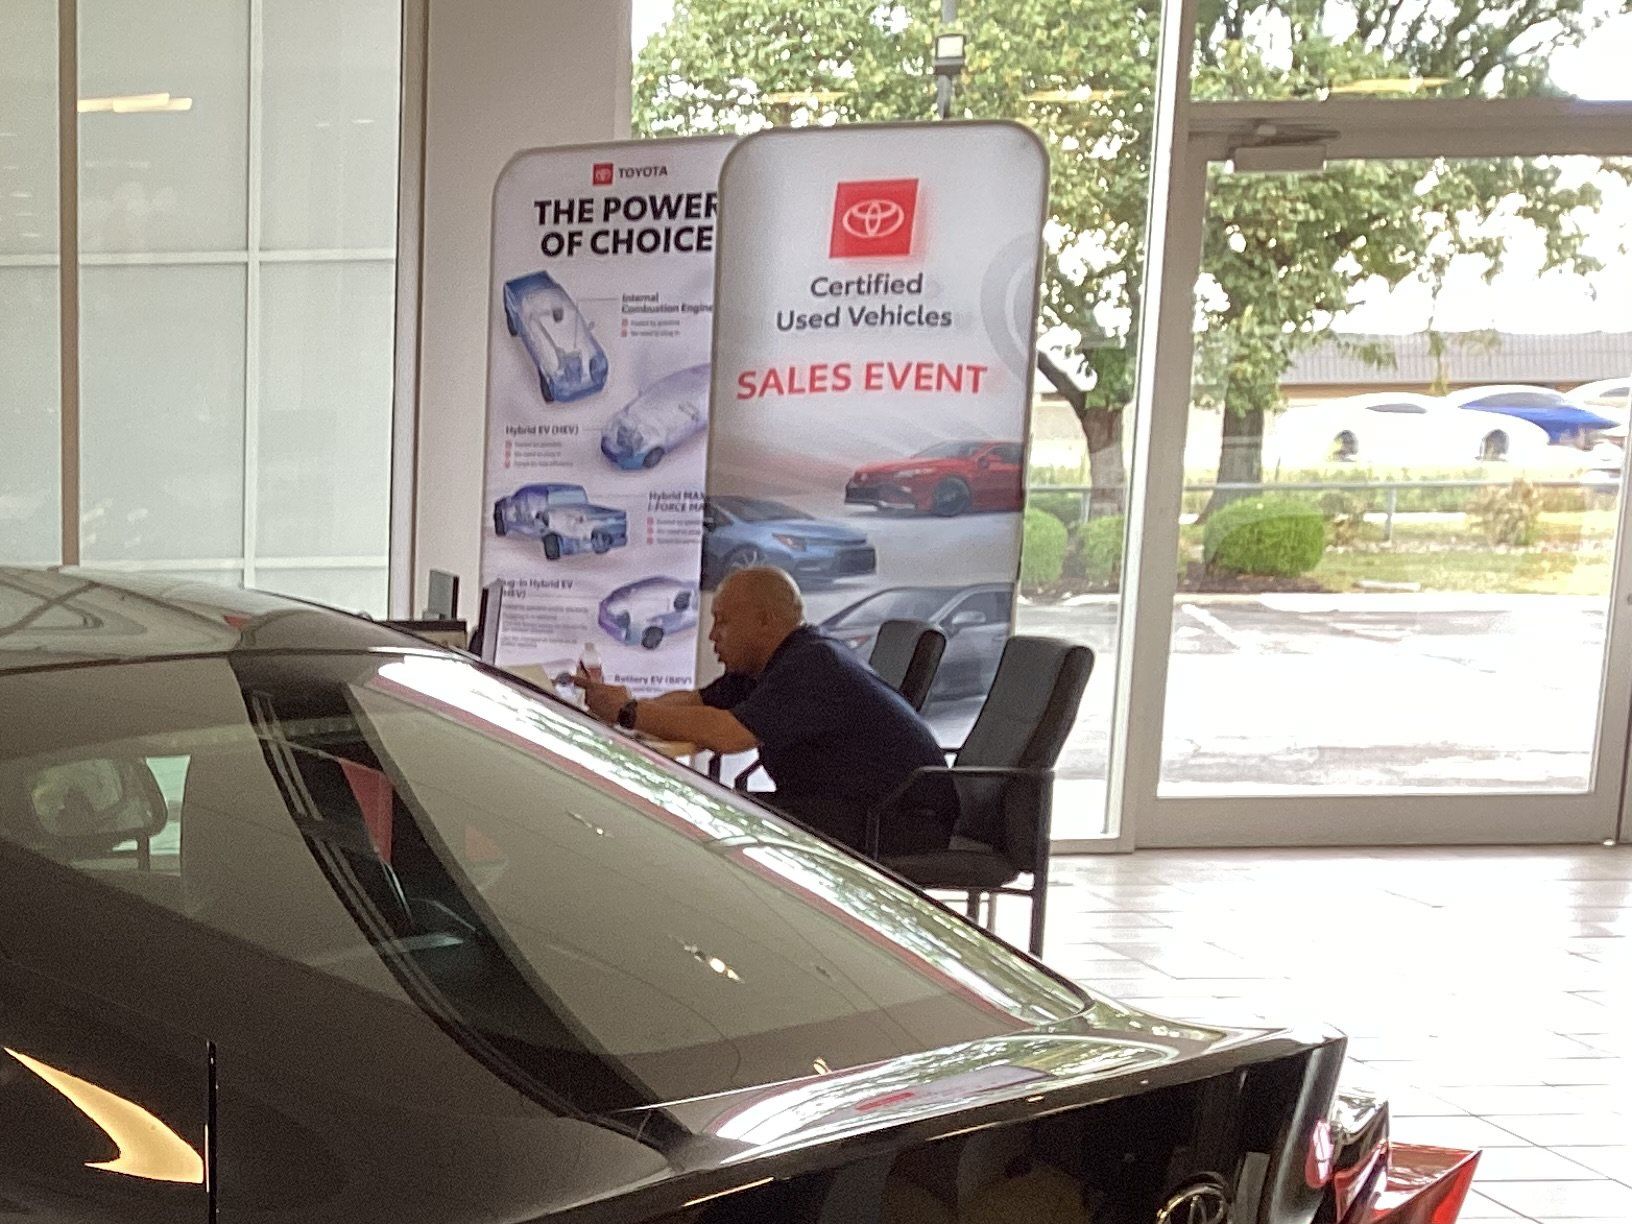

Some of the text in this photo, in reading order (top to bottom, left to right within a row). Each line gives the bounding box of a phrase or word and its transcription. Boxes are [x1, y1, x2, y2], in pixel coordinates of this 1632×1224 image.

[619, 166, 668, 178] TOYOTA
[534, 192, 718, 226] THE POWER
[541, 225, 714, 257] OF CHOICE
[810, 273, 924, 297] Certified
[776, 304, 953, 332] Used Vehicles
[736, 361, 988, 400] SALES EVENT
